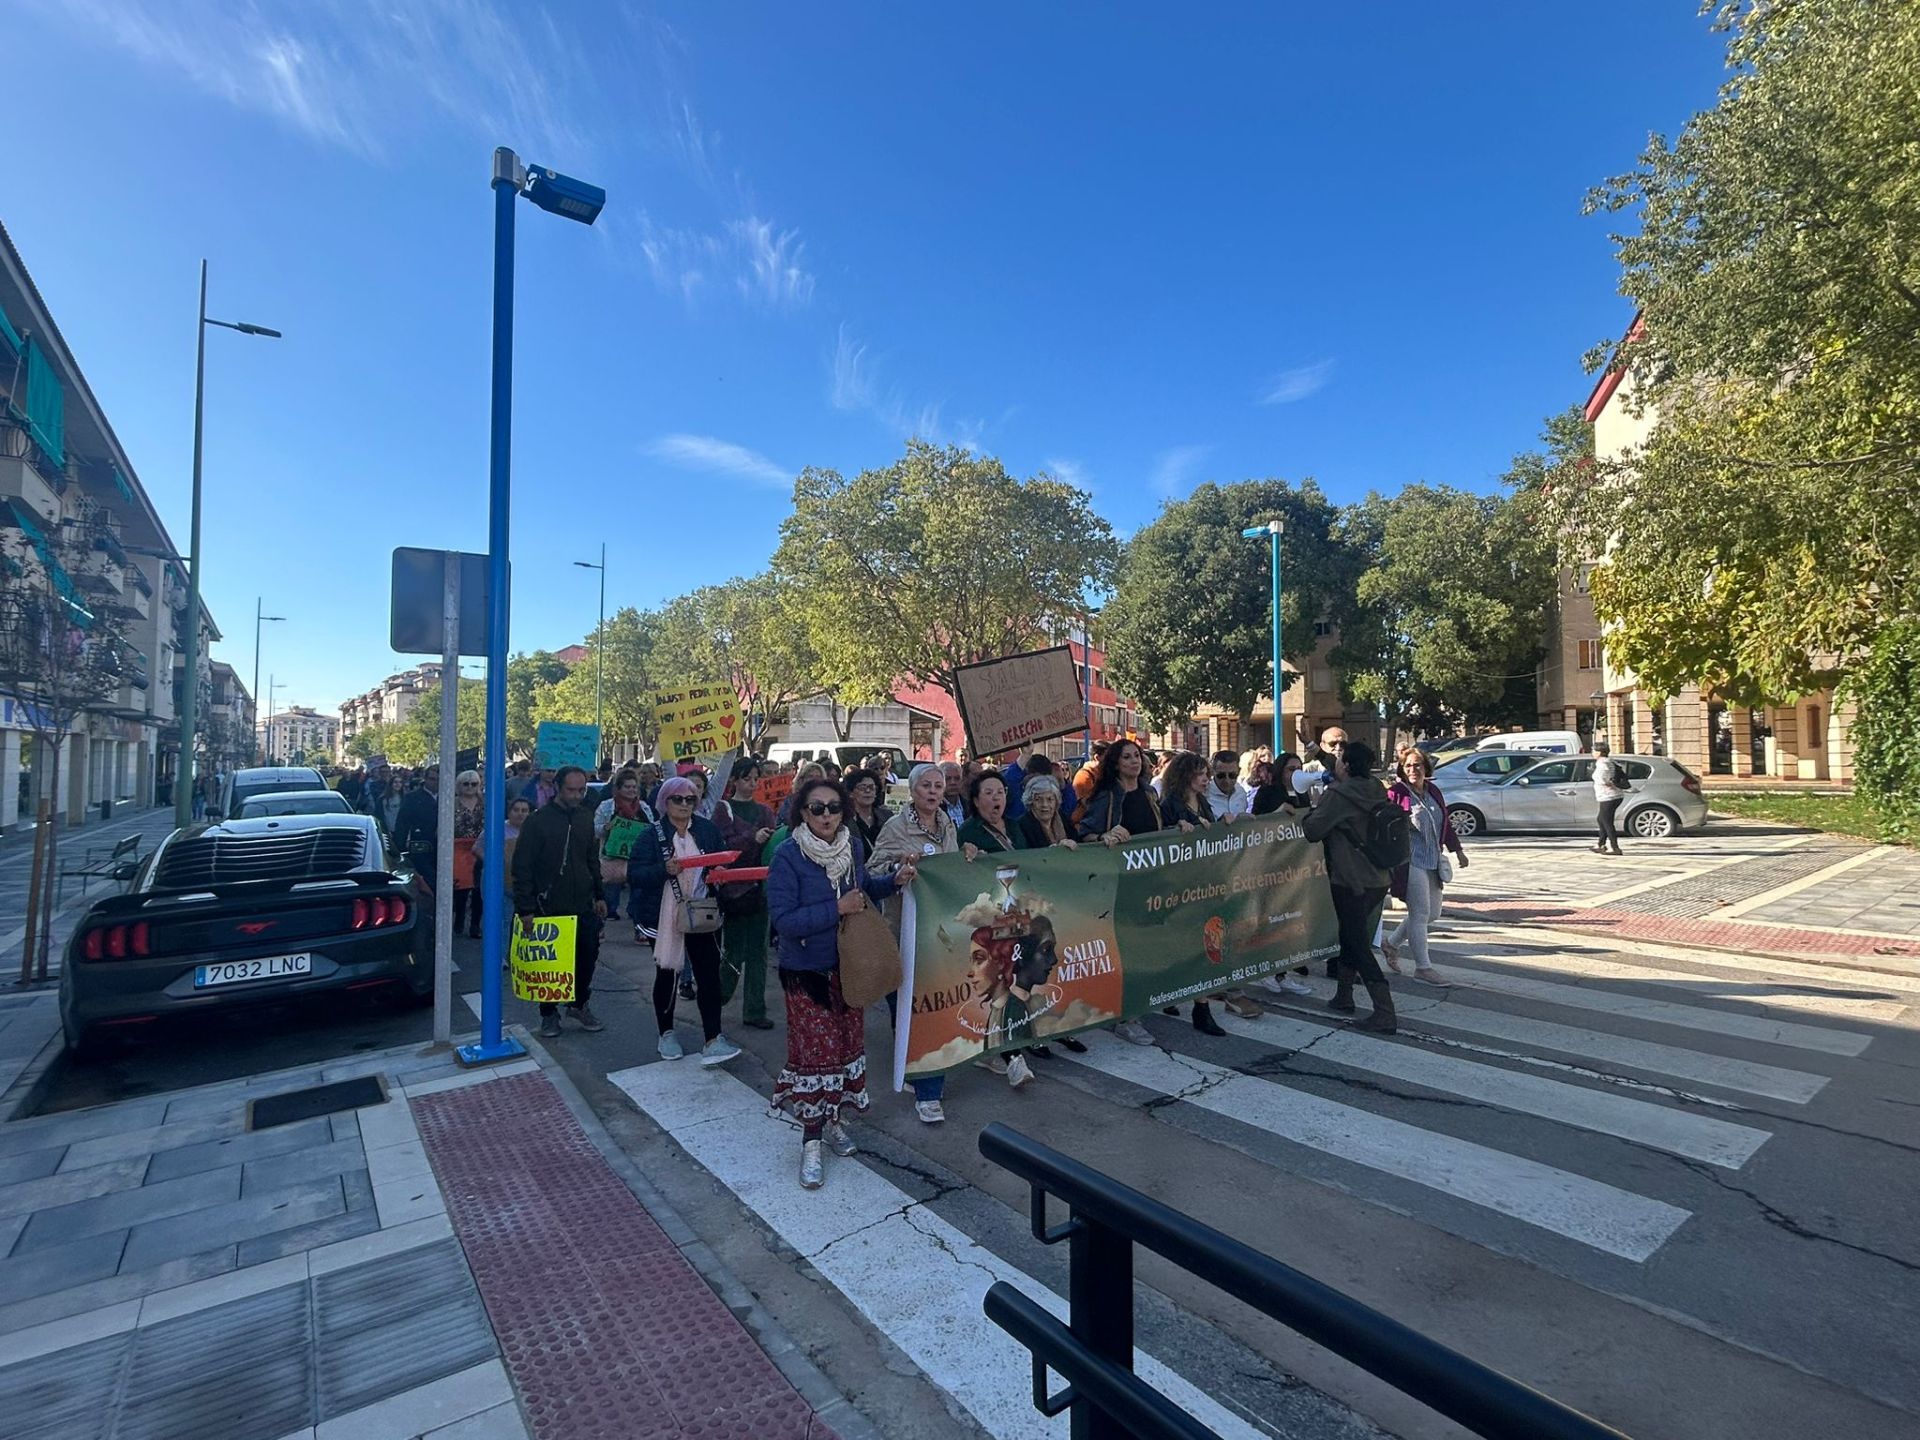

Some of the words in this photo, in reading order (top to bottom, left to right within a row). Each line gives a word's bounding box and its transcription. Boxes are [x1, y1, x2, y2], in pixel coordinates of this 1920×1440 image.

[689, 687, 711, 699] PEDIR
[660, 712, 675, 724] HOY
[679, 710, 686, 720] Y
[723, 699, 734, 710] EN
[673, 737, 718, 757] BASTA
[721, 731, 737, 748] YA
[1001, 718, 1043, 744] DERECHO
[1122, 846, 1165, 870] XXVI
[1169, 843, 1193, 864] Día
[1196, 832, 1244, 858] Mundial
[1247, 829, 1261, 847] de
[1264, 827, 1275, 844] la
[1277, 822, 1305, 841] Salu
[1146, 895, 1162, 911] 10
[1165, 894, 1178, 908] de
[1232, 863, 1311, 893] Extremadura
[1011, 943, 1023, 961] &
[1063, 939, 1107, 965] SALUD
[210, 961, 262, 982] 7032
[269, 956, 306, 974] LNC
[1057, 956, 1115, 983] MENTAL
[1259, 960, 1270, 974] 100
[911, 982, 971, 1014] RABAJO
